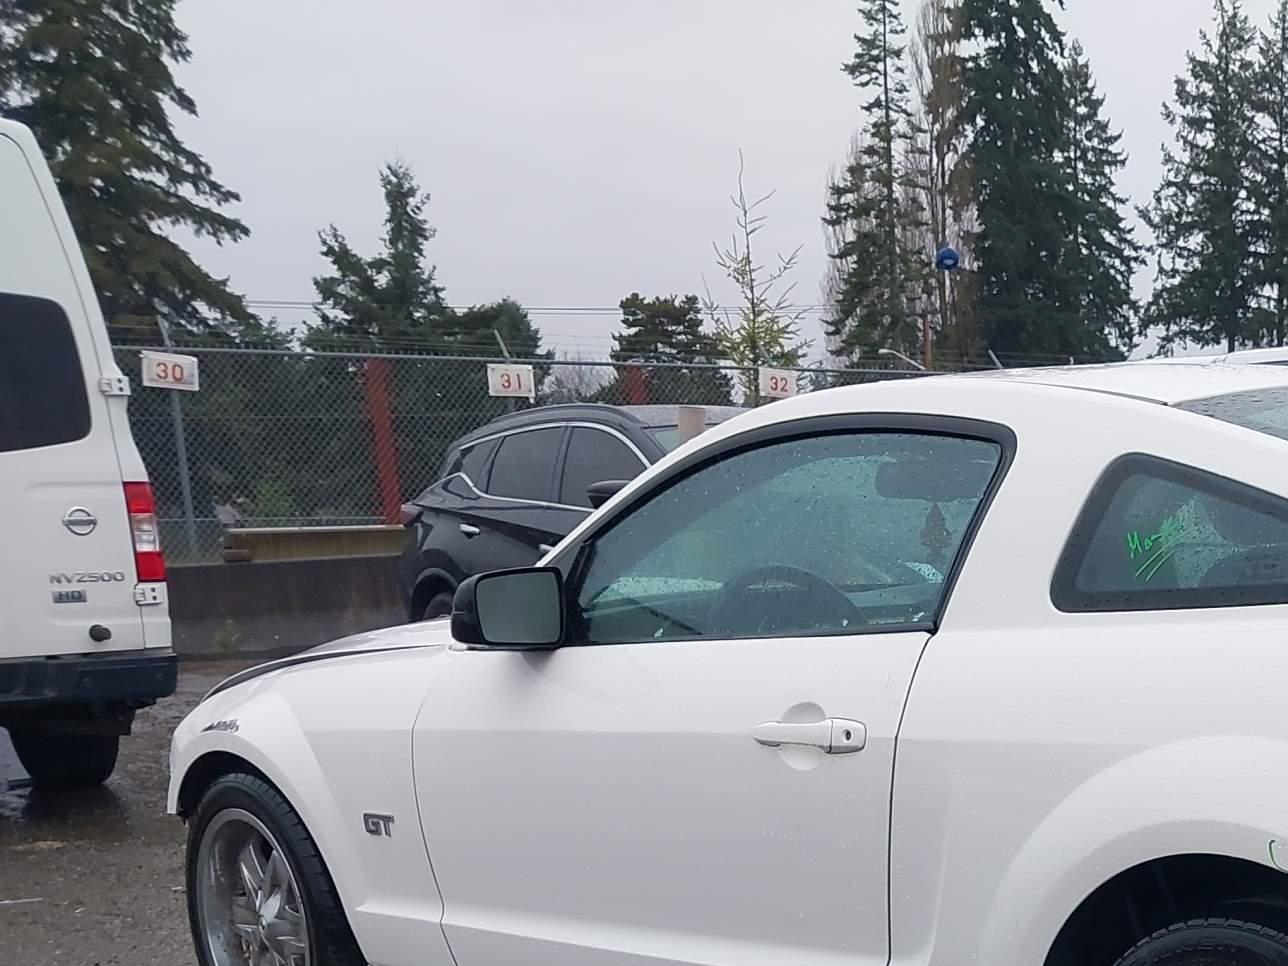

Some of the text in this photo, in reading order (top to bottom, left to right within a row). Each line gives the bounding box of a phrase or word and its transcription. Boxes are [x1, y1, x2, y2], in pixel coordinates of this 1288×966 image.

[155, 361, 184, 383] 30
[500, 372, 522, 390] 31
[770, 375, 788, 393] 32
[49, 571, 126, 585] NV2500
[58, 590, 82, 601] HD
[363, 812, 395, 838] GT
